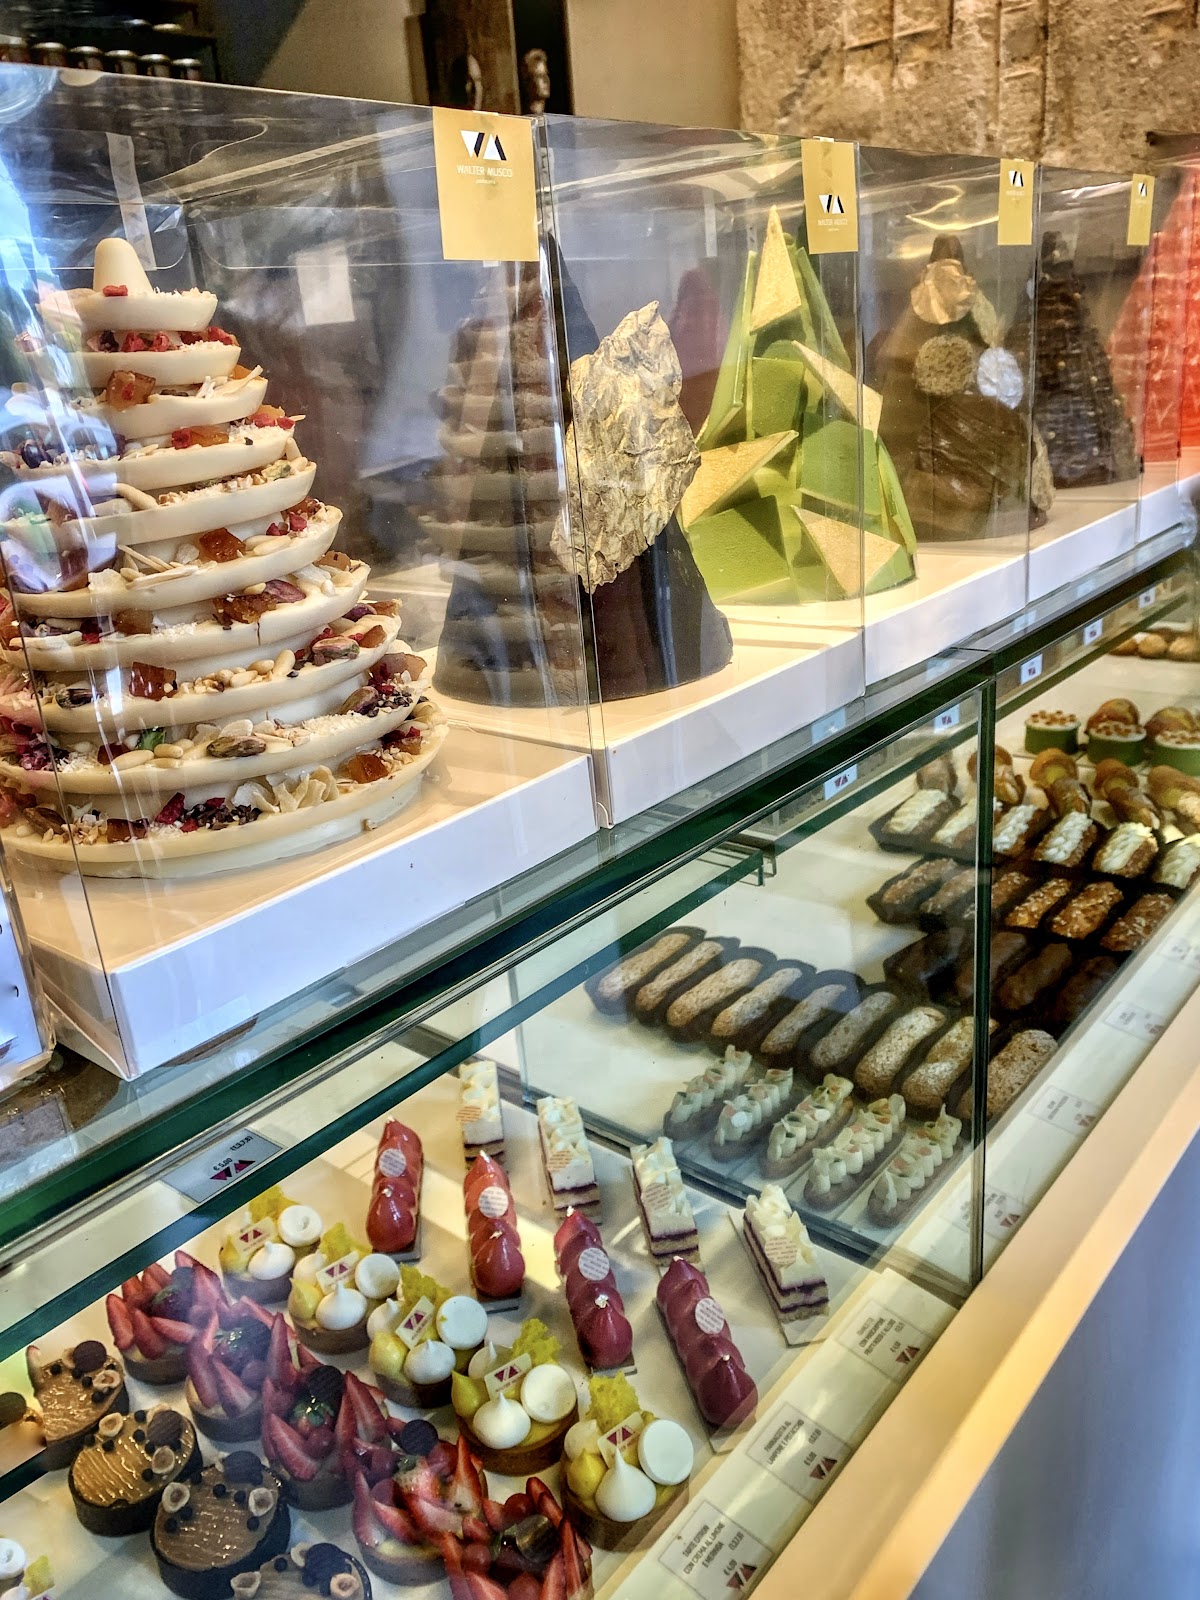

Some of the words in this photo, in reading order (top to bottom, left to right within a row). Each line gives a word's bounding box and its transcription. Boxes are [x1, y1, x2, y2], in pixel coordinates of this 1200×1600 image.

[456, 165, 485, 176] WALTER
[487, 167, 513, 178] MUSCO
[683, 1561, 694, 1574] CON
[691, 1545, 707, 1563] CREMA
[709, 1522, 724, 1540] LIMONE
[683, 1541, 696, 1556] TARTE
